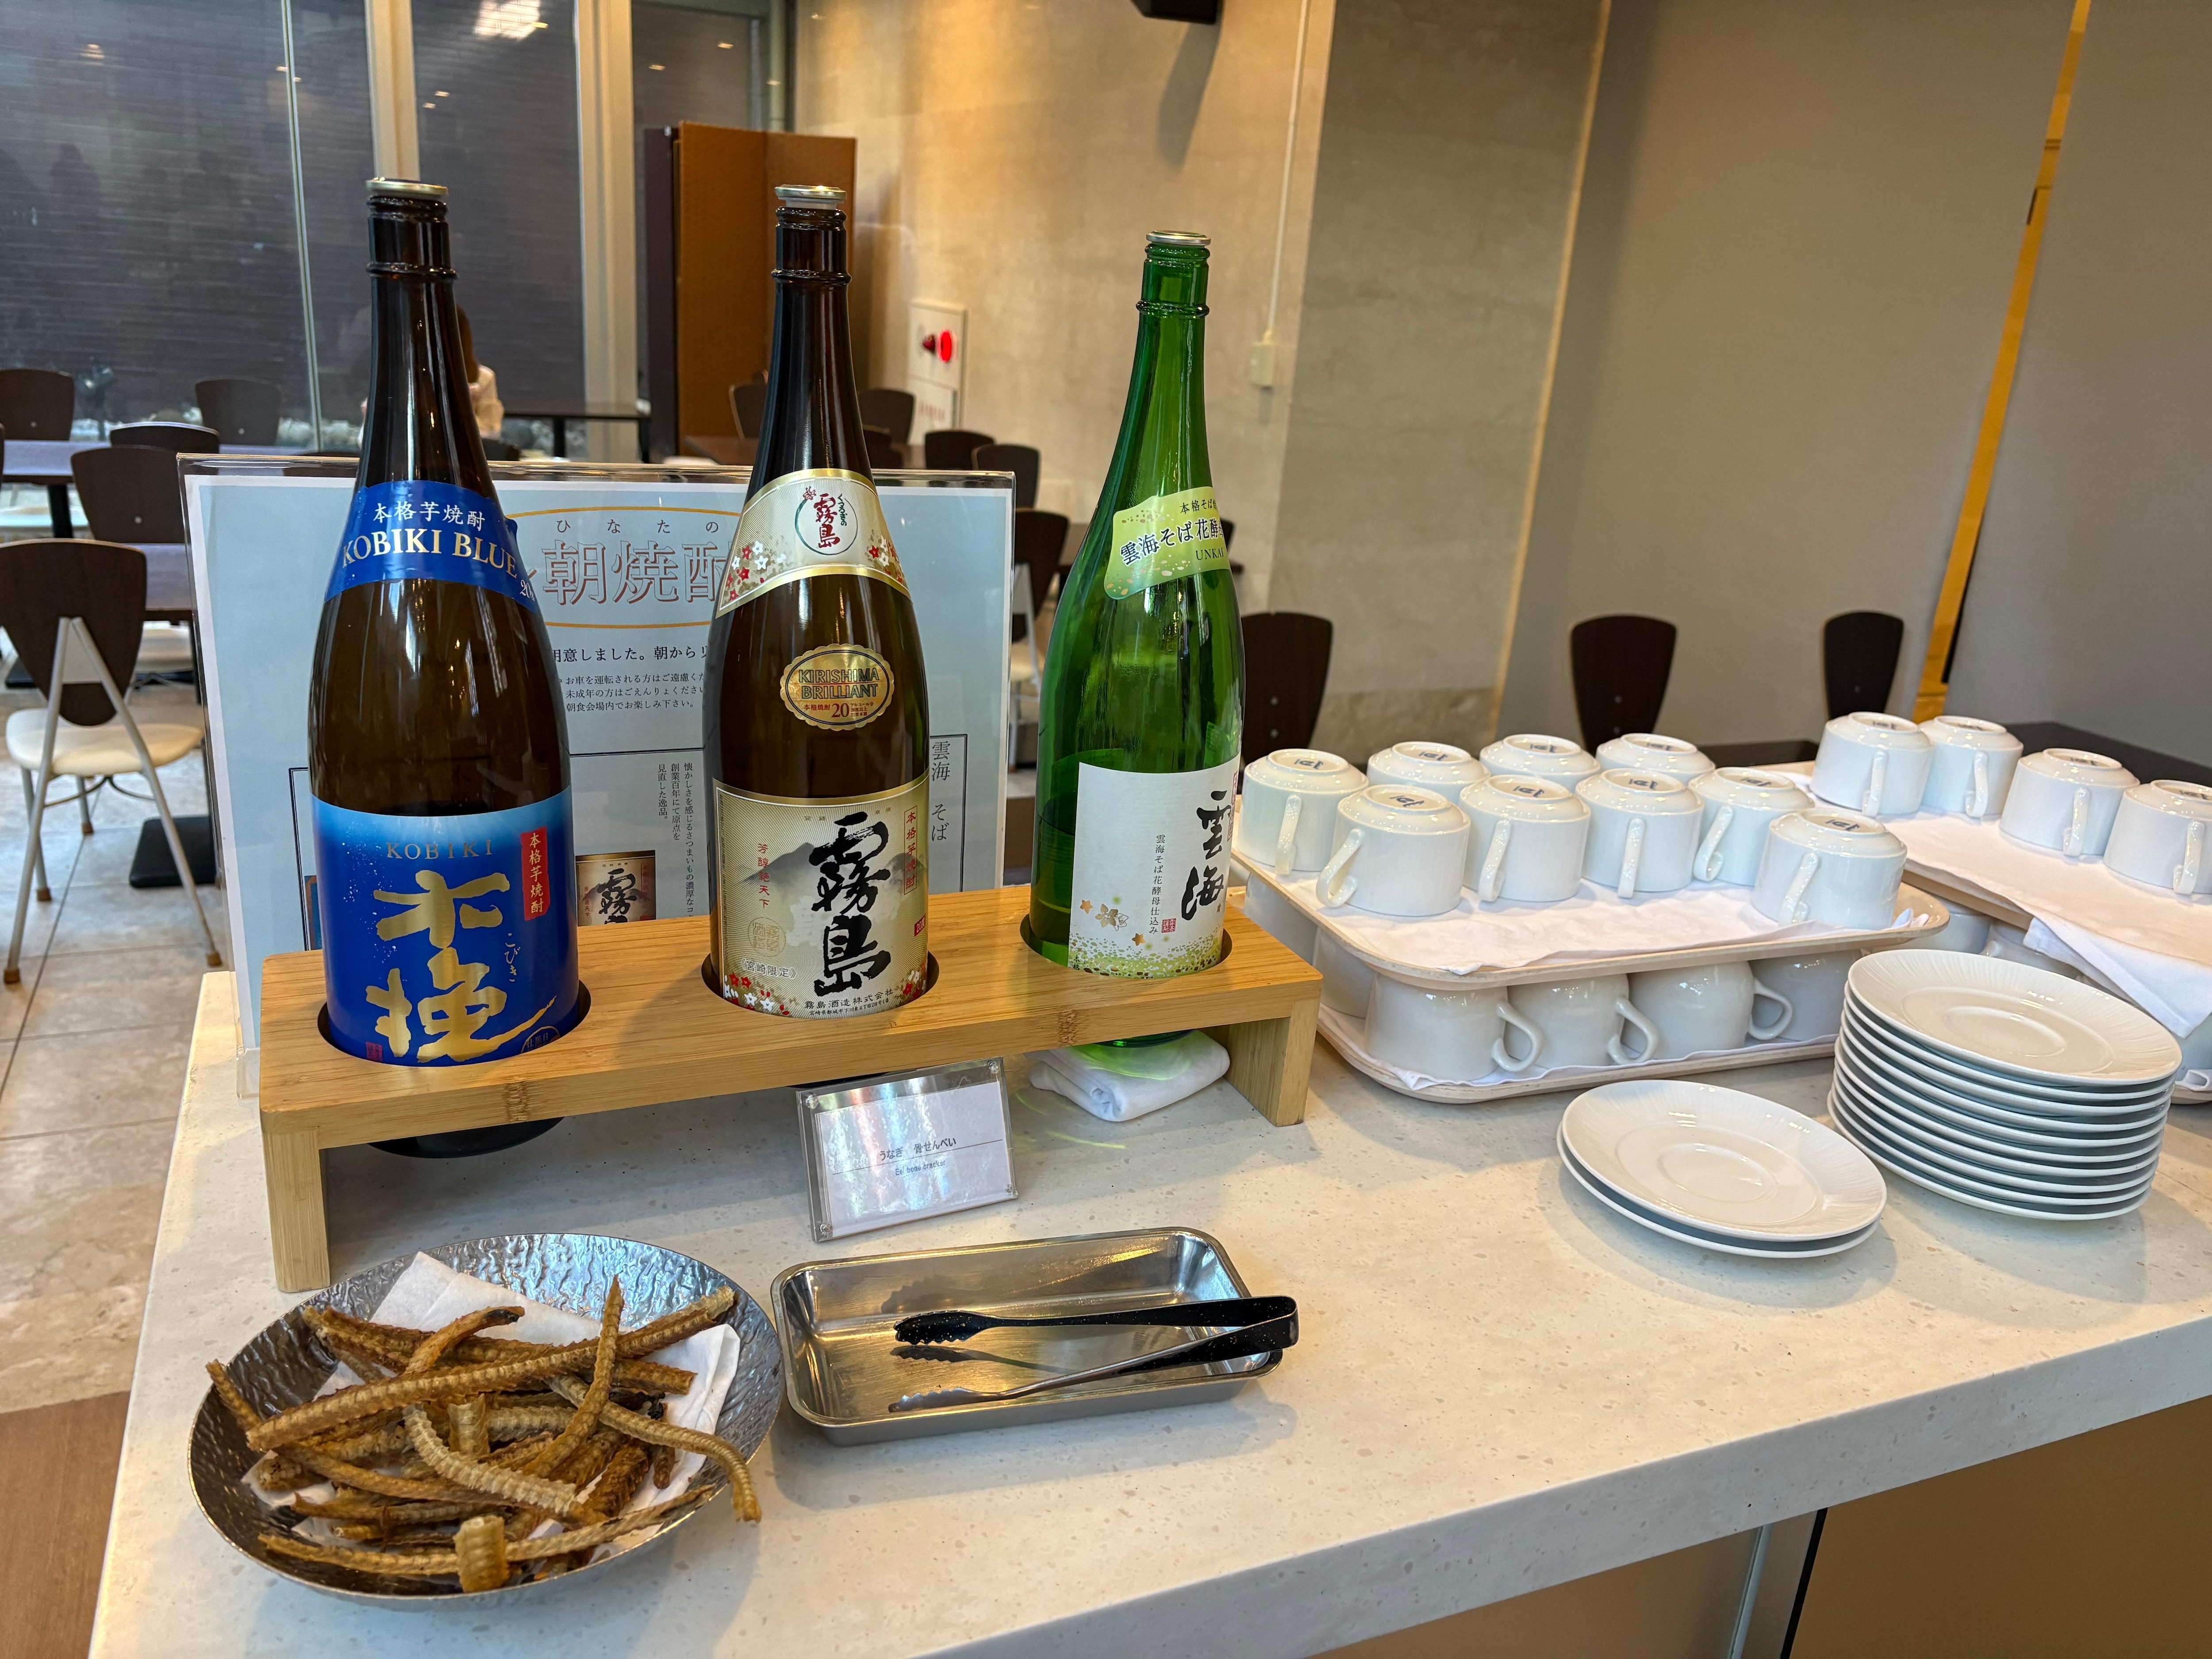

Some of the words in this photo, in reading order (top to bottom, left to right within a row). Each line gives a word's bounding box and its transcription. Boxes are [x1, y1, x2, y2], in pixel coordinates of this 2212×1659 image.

[373, 501, 485, 531] 本格芋焼酎
[557, 519, 719, 534] ひなたの
[813, 493, 841, 549] 霧島
[342, 528, 442, 568] KOBIKI
[452, 532, 517, 579] BLUE
[1196, 547, 1224, 561] UNKAI
[799, 668, 880, 683] KIRISHIMA
[802, 684, 878, 699] BRILLIANT
[566, 699, 694, 712] 朝食会場内でお楽しみ下さい。
[831, 703, 849, 718] 20
[932, 741, 950, 781] 雲海
[657, 764, 668, 820] 見直した逸品。
[671, 763, 680, 841] 創業百年にて原点を
[932, 803, 949, 842] そば
[386, 840, 493, 860] KOBIKI
[906, 811, 916, 890] 本格芋焼酎
[1181, 790, 1232, 921] 雲海
[530, 833, 544, 914] 本格芋焼酎
[1149, 834, 1166, 934] 雲海そば花酵母仕込み
[809, 811, 891, 997] 霧島
[504, 933, 521, 982] こびき
[804, 988, 893, 1009] 霧島酒造株式会社
[880, 1146, 904, 1161] うなぎ
[914, 1138, 956, 1154] 骨せんべい
[907, 1165, 921, 1173] bone
[923, 1160, 946, 1170] cracker
